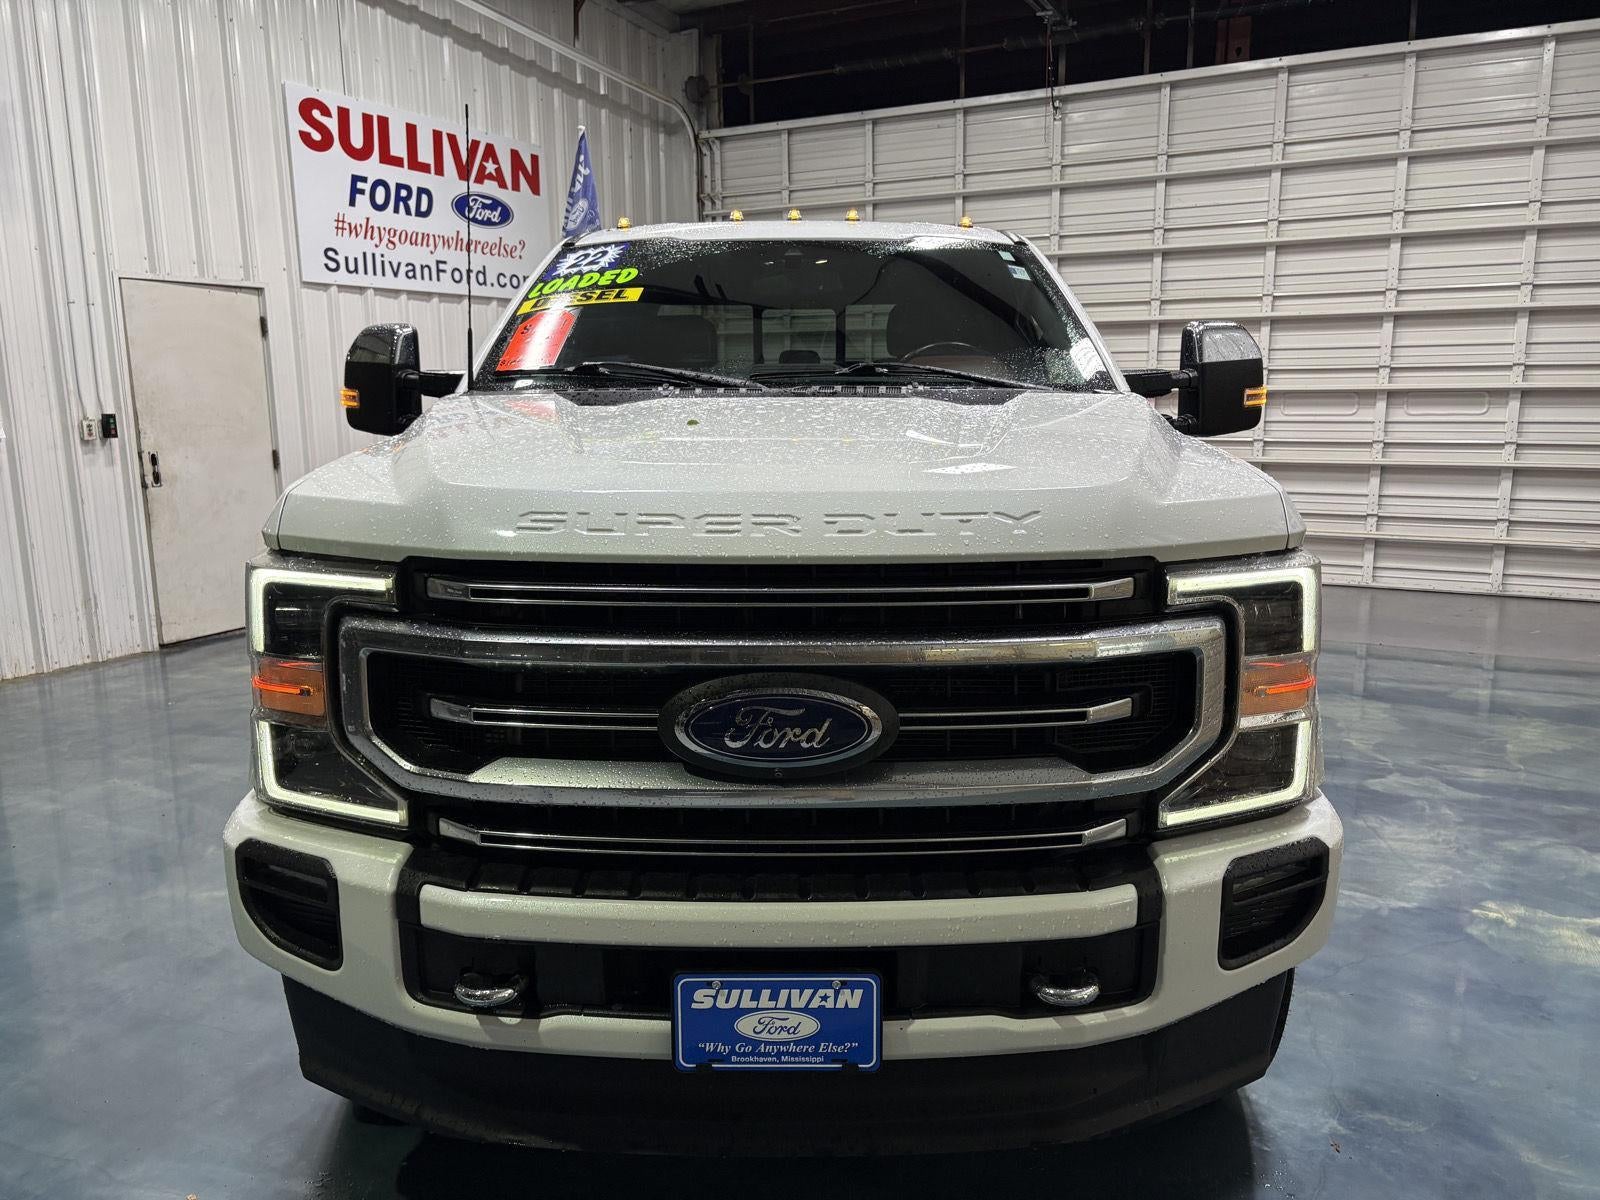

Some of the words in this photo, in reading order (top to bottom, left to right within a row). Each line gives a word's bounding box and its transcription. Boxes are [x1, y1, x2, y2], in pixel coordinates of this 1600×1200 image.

[298, 97, 541, 196] SULLIVAN
[348, 174, 434, 218] FORD
[465, 196, 502, 223] Ford
[334, 212, 527, 261] #whygoanywhereelse?
[323, 246, 530, 290] SullivanFord.co
[566, 250, 608, 270] 22
[528, 267, 639, 299] LOADED
[530, 288, 628, 311] DSEL
[514, 510, 802, 537] SUPER
[823, 509, 1042, 537] DUTY
[724, 705, 833, 749] Ford
[690, 988, 864, 1010] SULLIVAN
[752, 1015, 802, 1036] Ford
[731, 1055, 780, 1063] Brookhaven,
[781, 1055, 825, 1064] Mississippi
[735, 1042, 752, 1053] Go
[755, 1042, 815, 1055] Anywhere
